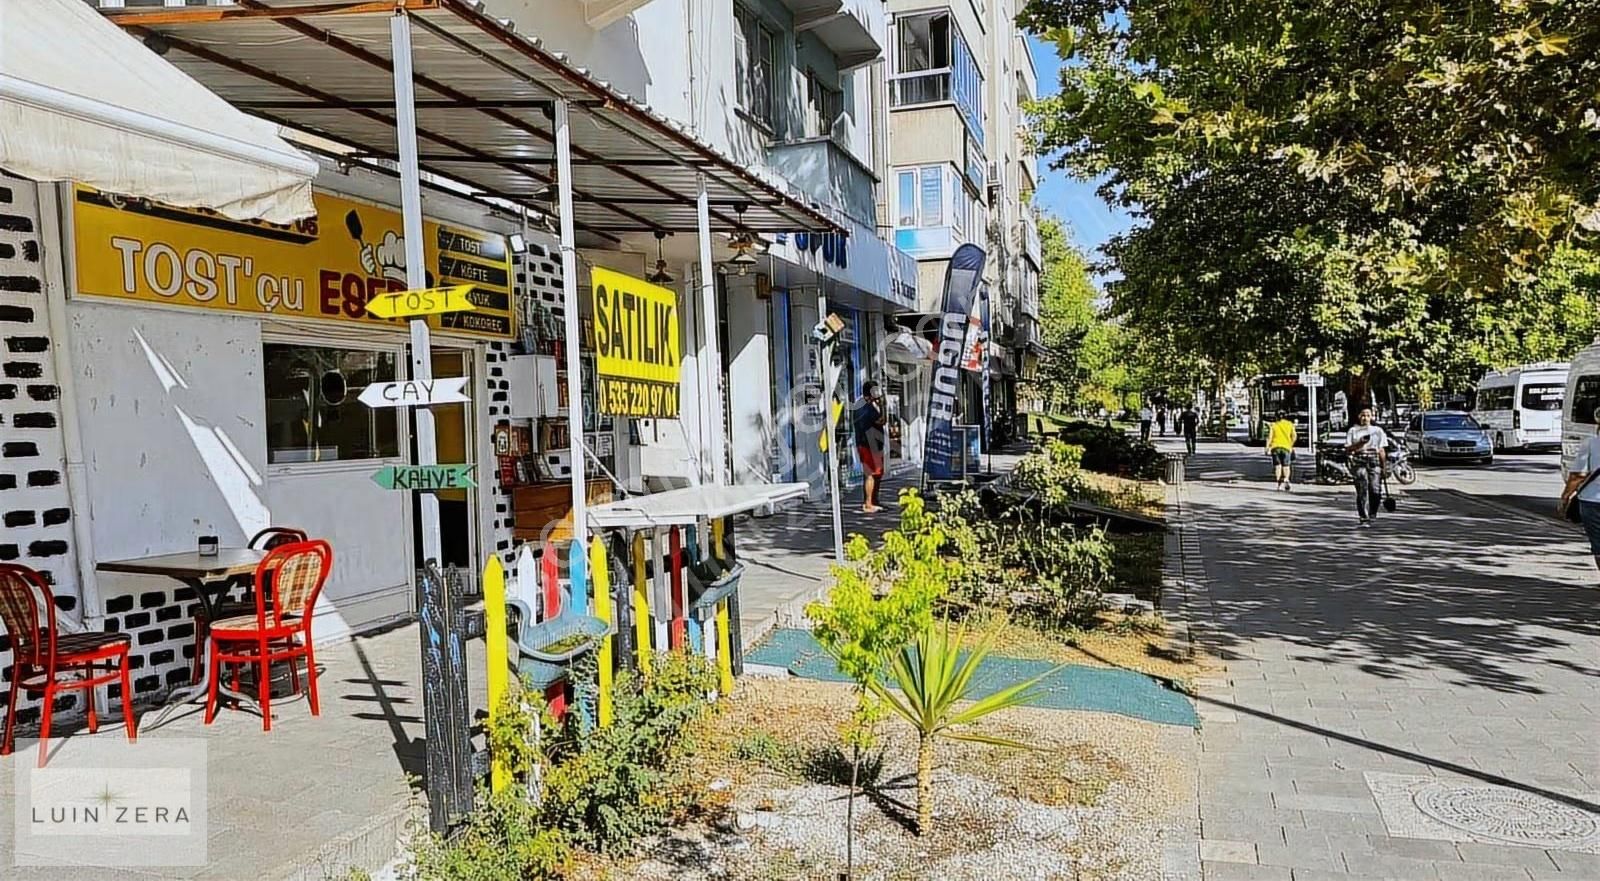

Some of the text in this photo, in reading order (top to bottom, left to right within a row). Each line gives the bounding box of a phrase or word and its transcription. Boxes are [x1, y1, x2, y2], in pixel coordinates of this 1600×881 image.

[461, 237, 480, 255] TOST
[111, 236, 305, 313] TOST'çu
[461, 263, 488, 281] KÖFTE
[385, 288, 457, 314] TOST
[464, 314, 502, 332] KOKOREÇ
[596, 284, 674, 367] SATILIK
[383, 381, 435, 403] ÇAY
[599, 378, 677, 417] 0 535 220 97 01
[393, 466, 456, 489] KAHVE
